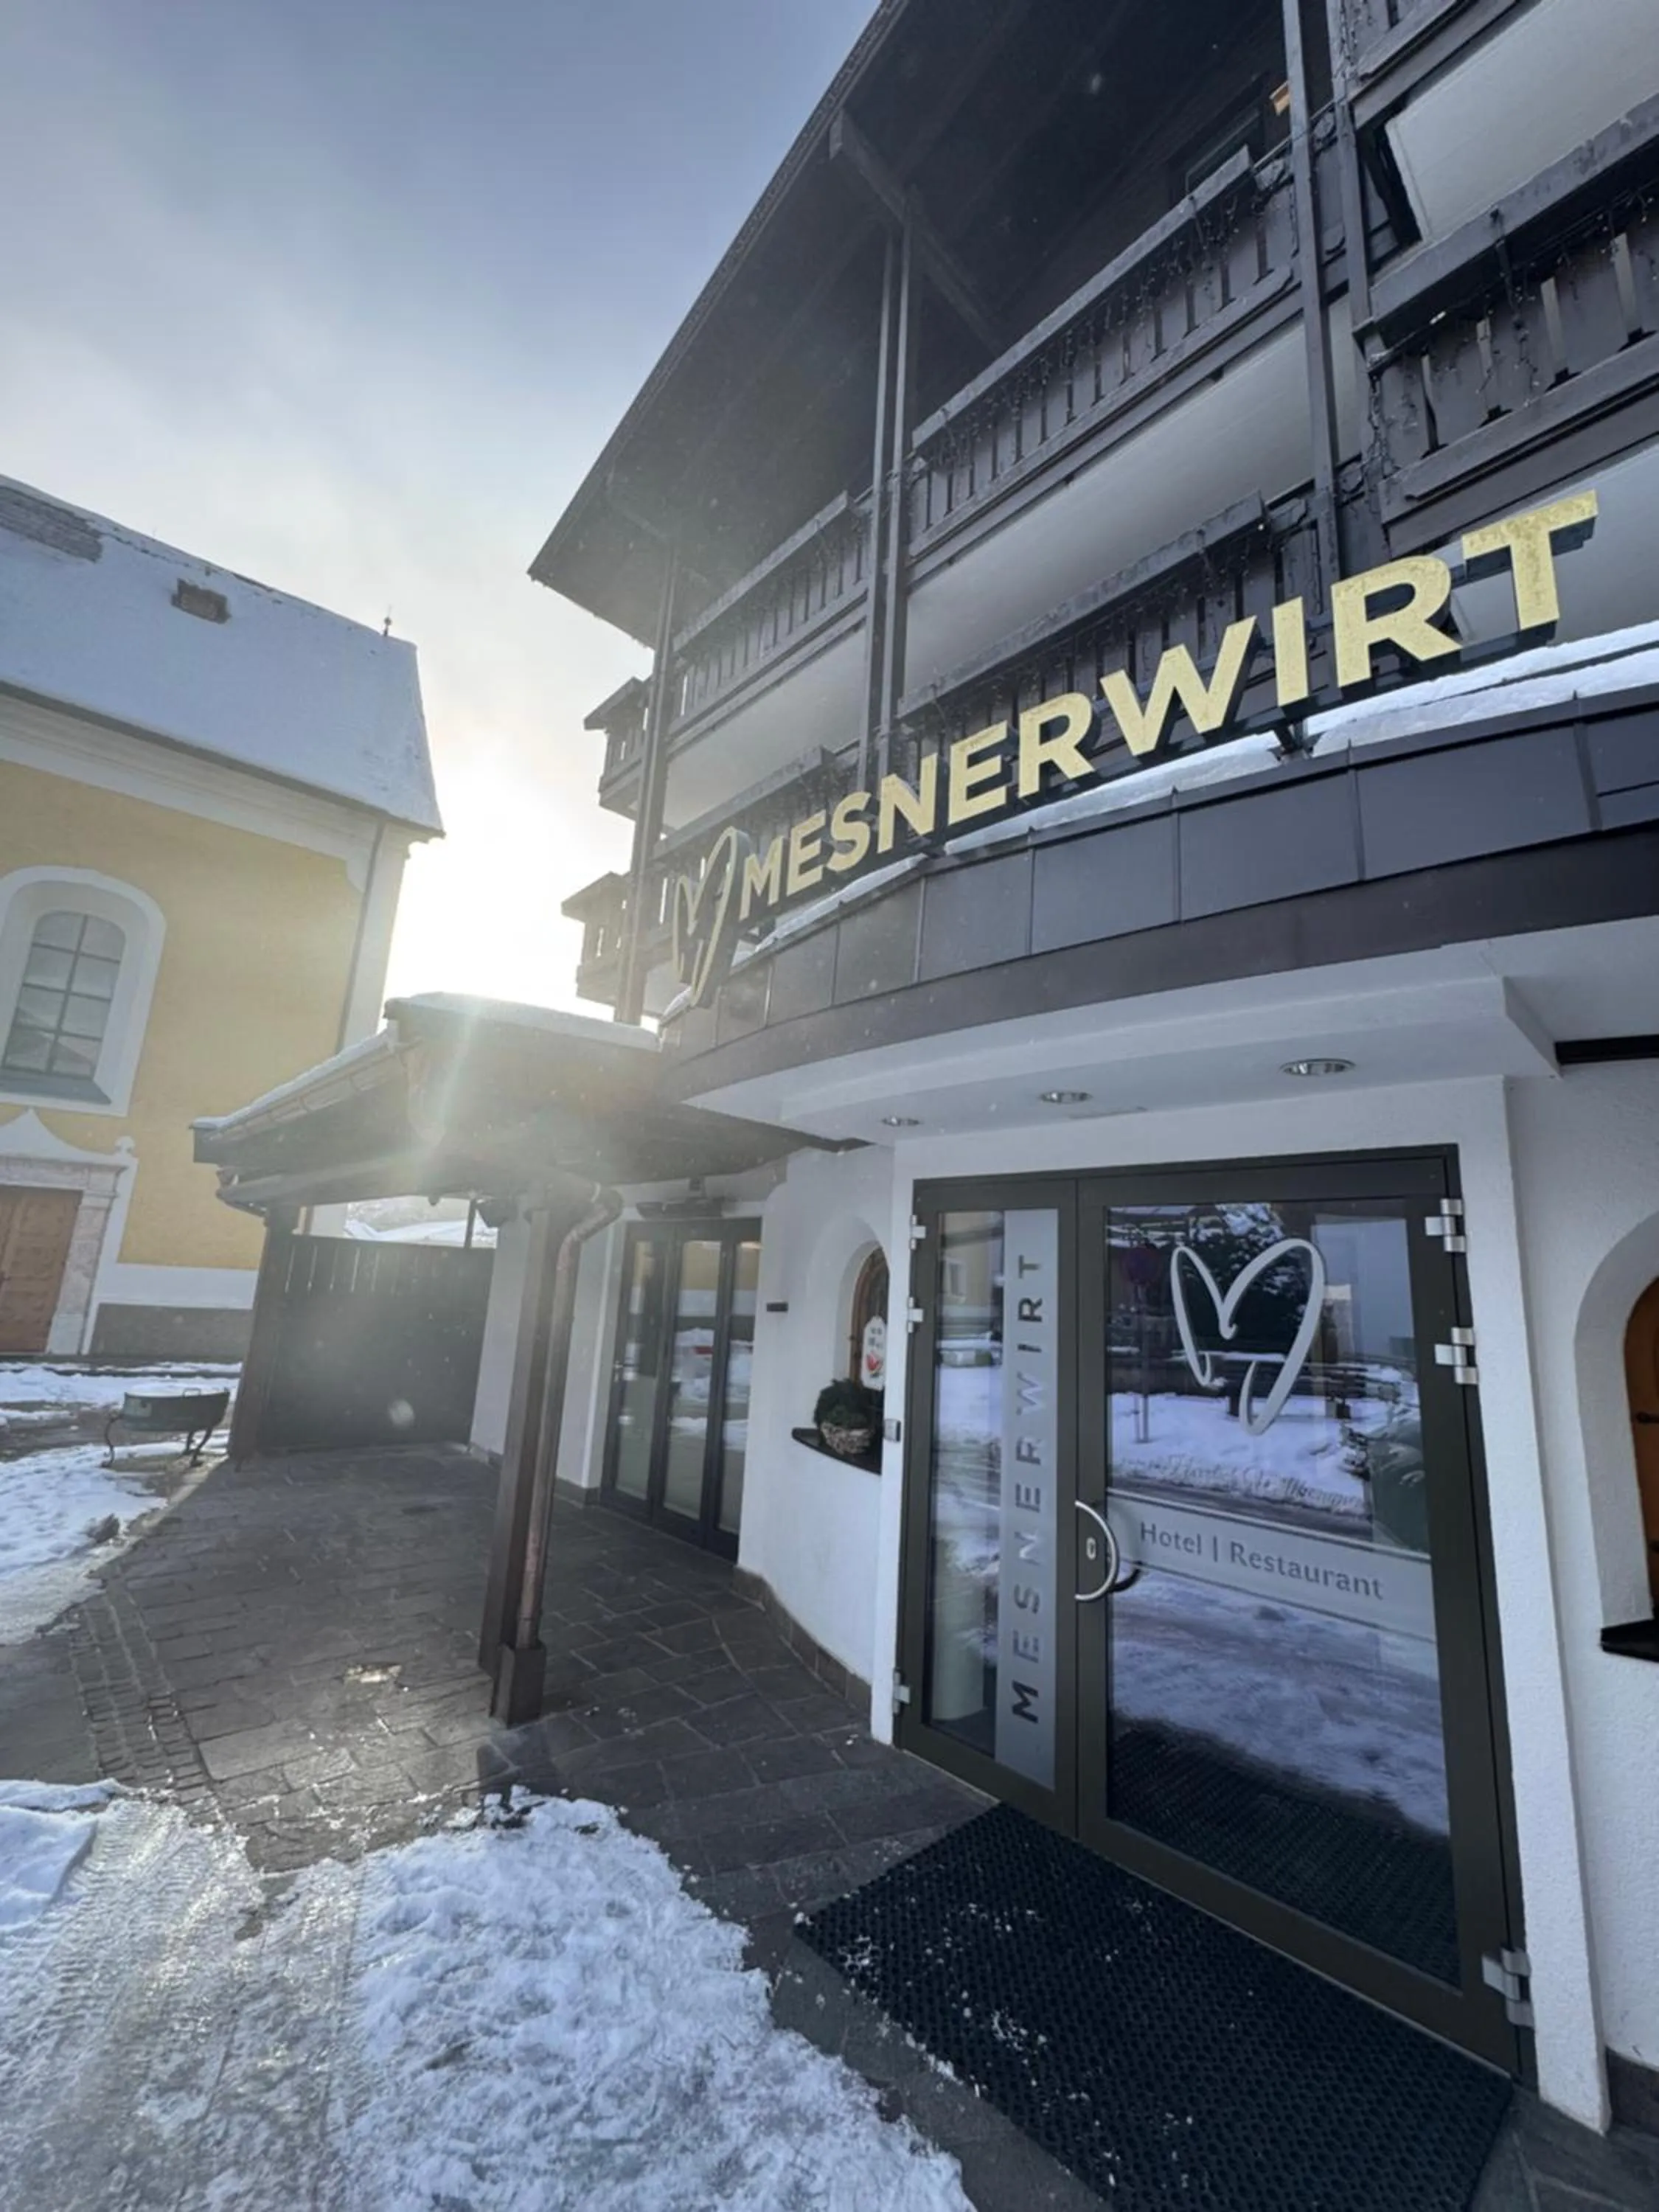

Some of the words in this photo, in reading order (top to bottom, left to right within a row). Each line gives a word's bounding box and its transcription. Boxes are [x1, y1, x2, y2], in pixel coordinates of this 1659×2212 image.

[739, 490, 1599, 921] MESNERWIRT
[1011, 1254, 1043, 1724] MESNERWIRT
[1140, 1521, 1202, 1554] Hotel
[1229, 1540, 1384, 1601] Restaurant
